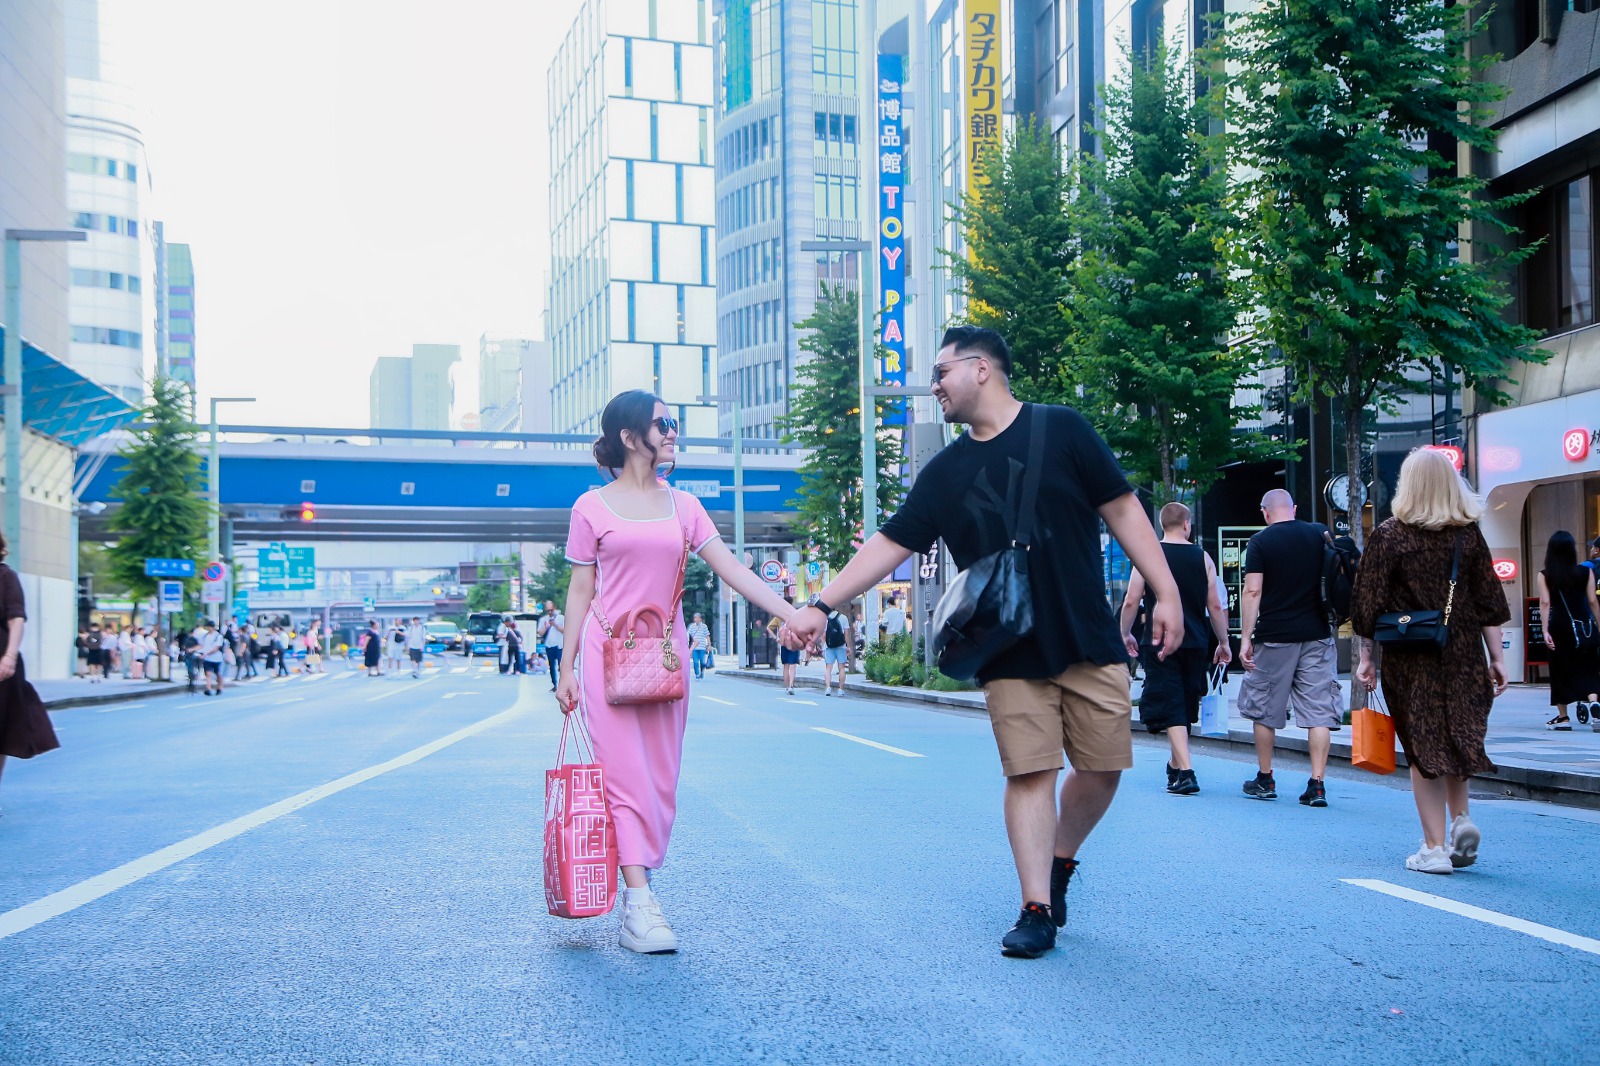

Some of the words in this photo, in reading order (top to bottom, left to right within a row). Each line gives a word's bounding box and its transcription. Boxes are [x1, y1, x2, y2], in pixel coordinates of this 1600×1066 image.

[880, 99, 902, 173] 博品館
[882, 186, 902, 270] TOY
